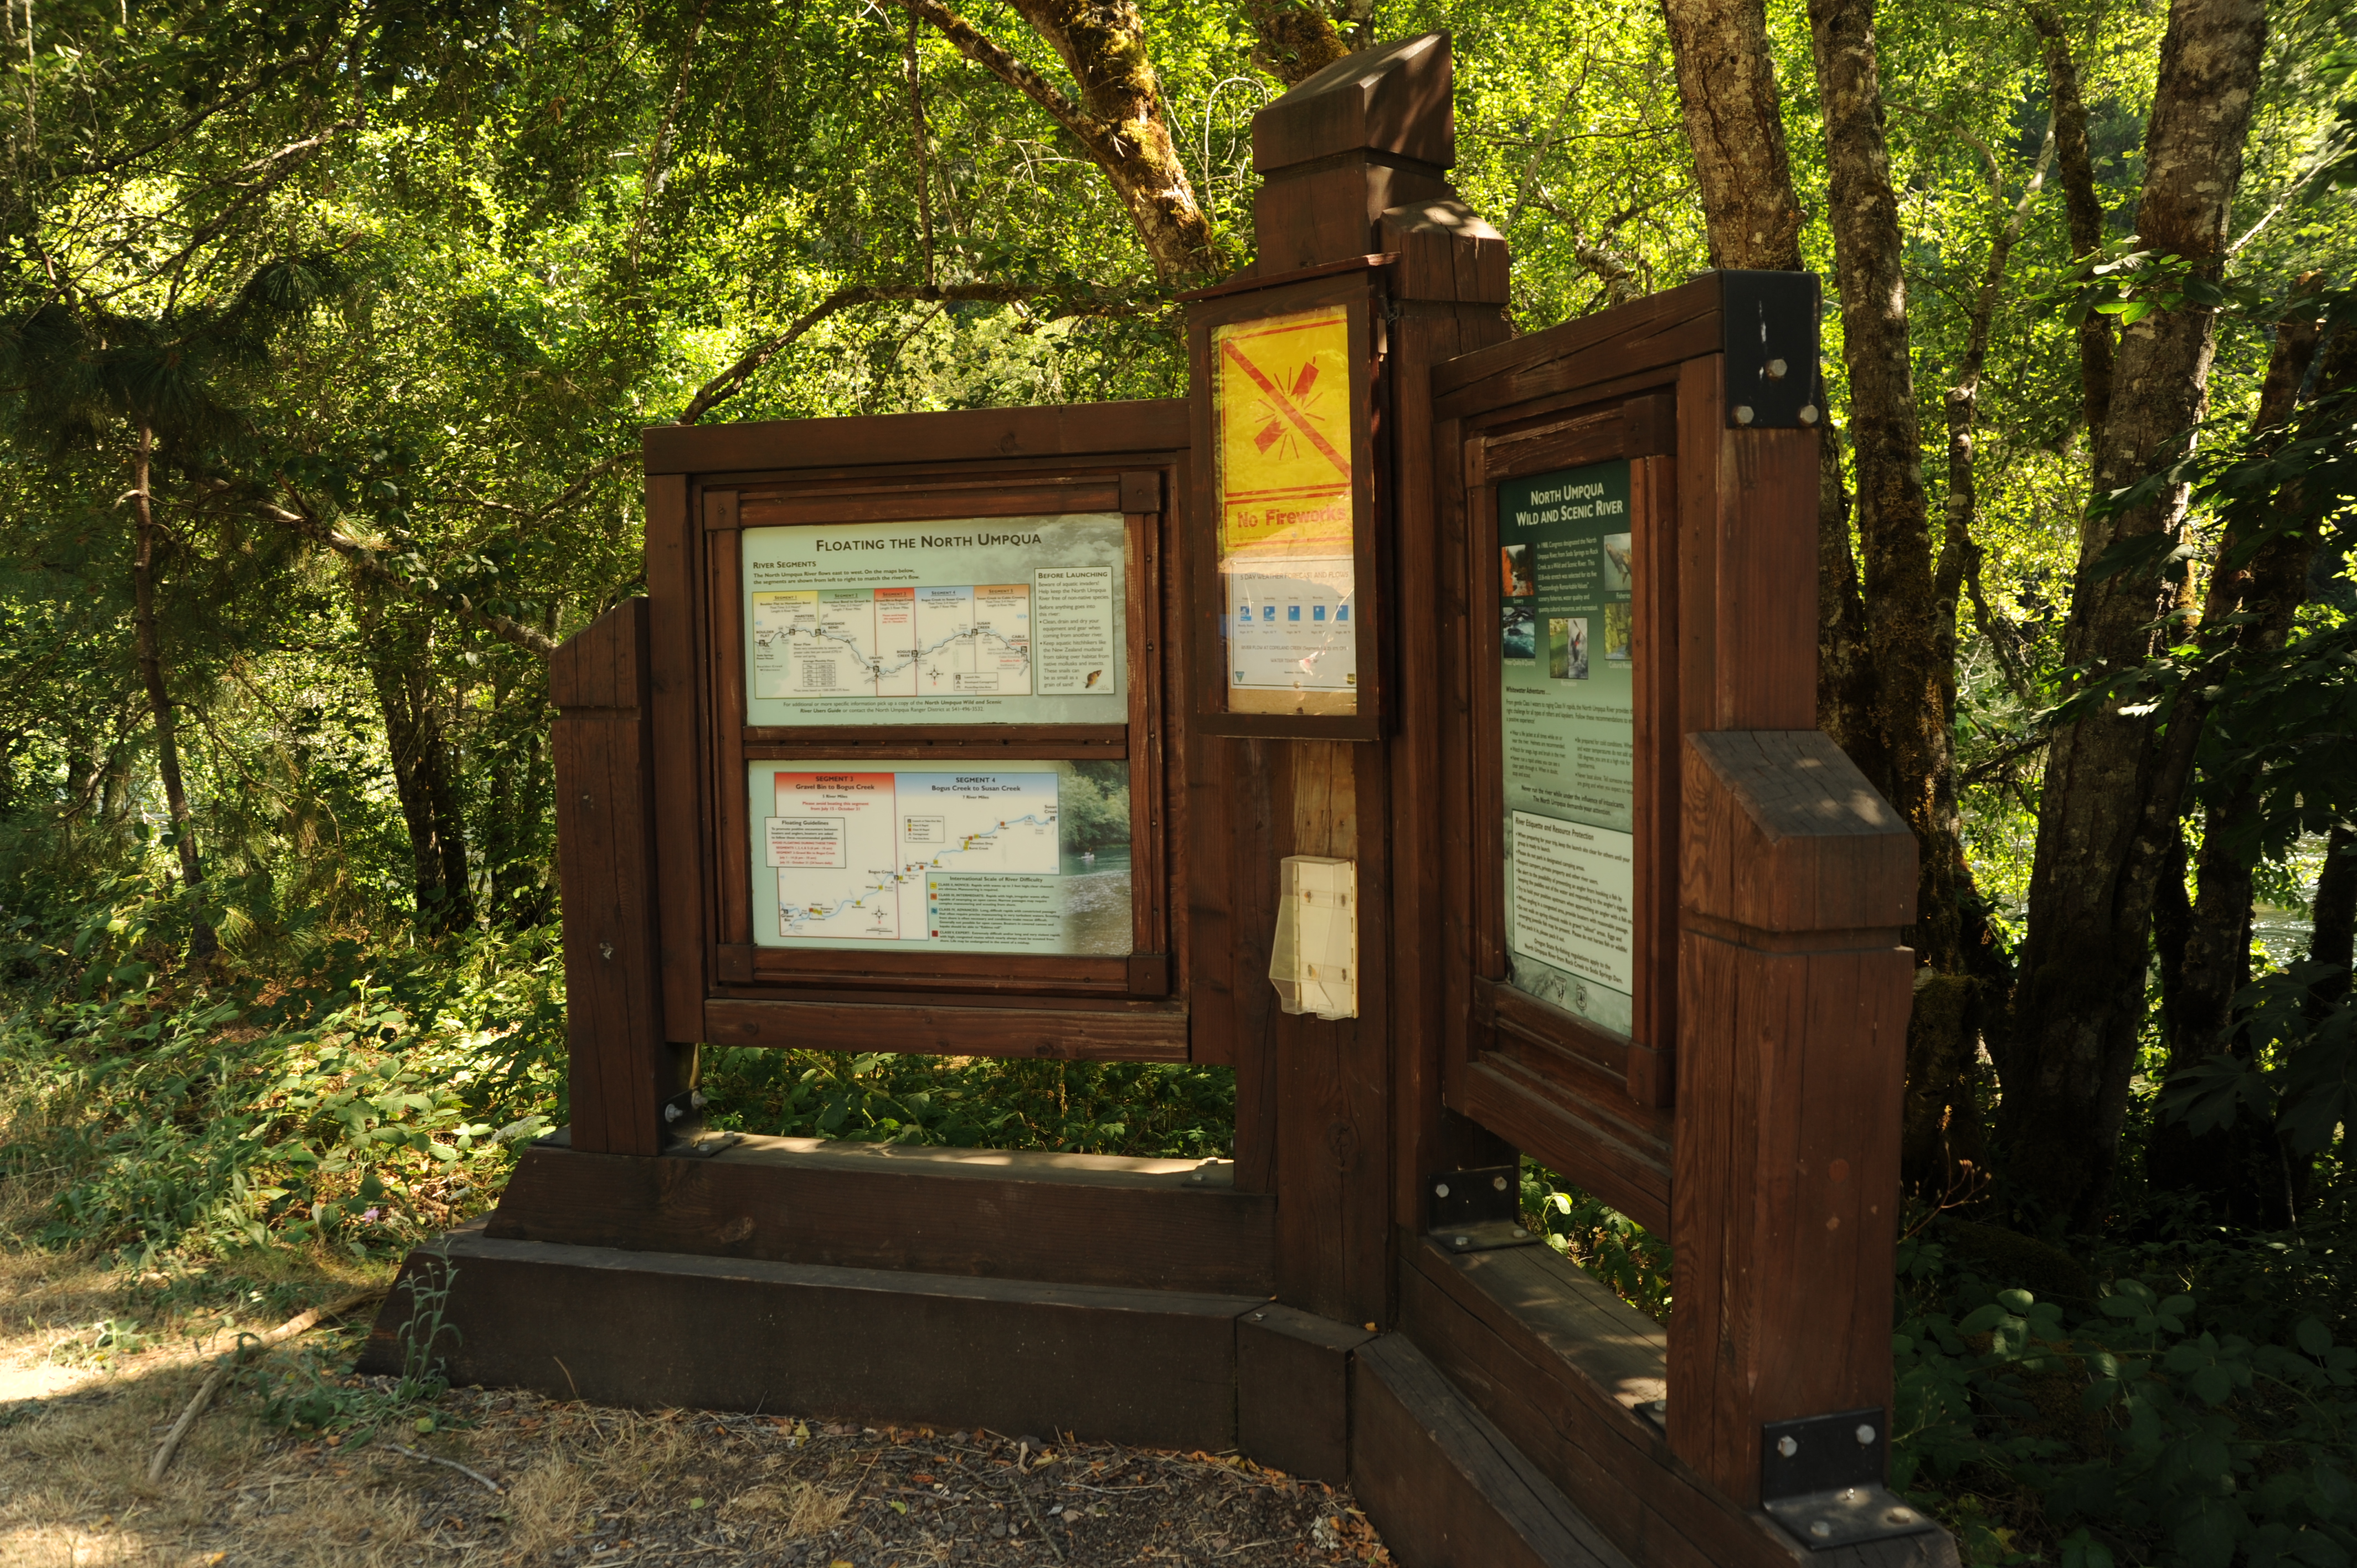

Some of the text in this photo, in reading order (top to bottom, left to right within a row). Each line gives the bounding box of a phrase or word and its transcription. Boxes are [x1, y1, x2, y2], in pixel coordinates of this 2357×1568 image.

[1531, 482, 1604, 506] NORTH UMPQUA
[1238, 504, 1346, 528] No Fireworks
[1516, 500, 1623, 527] WILD AND SCENIC RIVER
[816, 533, 1042, 551] FLOATING THE NORTH UMPQUA
[1515, 816, 1525, 826] River
[1525, 818, 1543, 830] Etiquette
[1552, 824, 1571, 836] Resource
[1572, 828, 1594, 840] Protection
